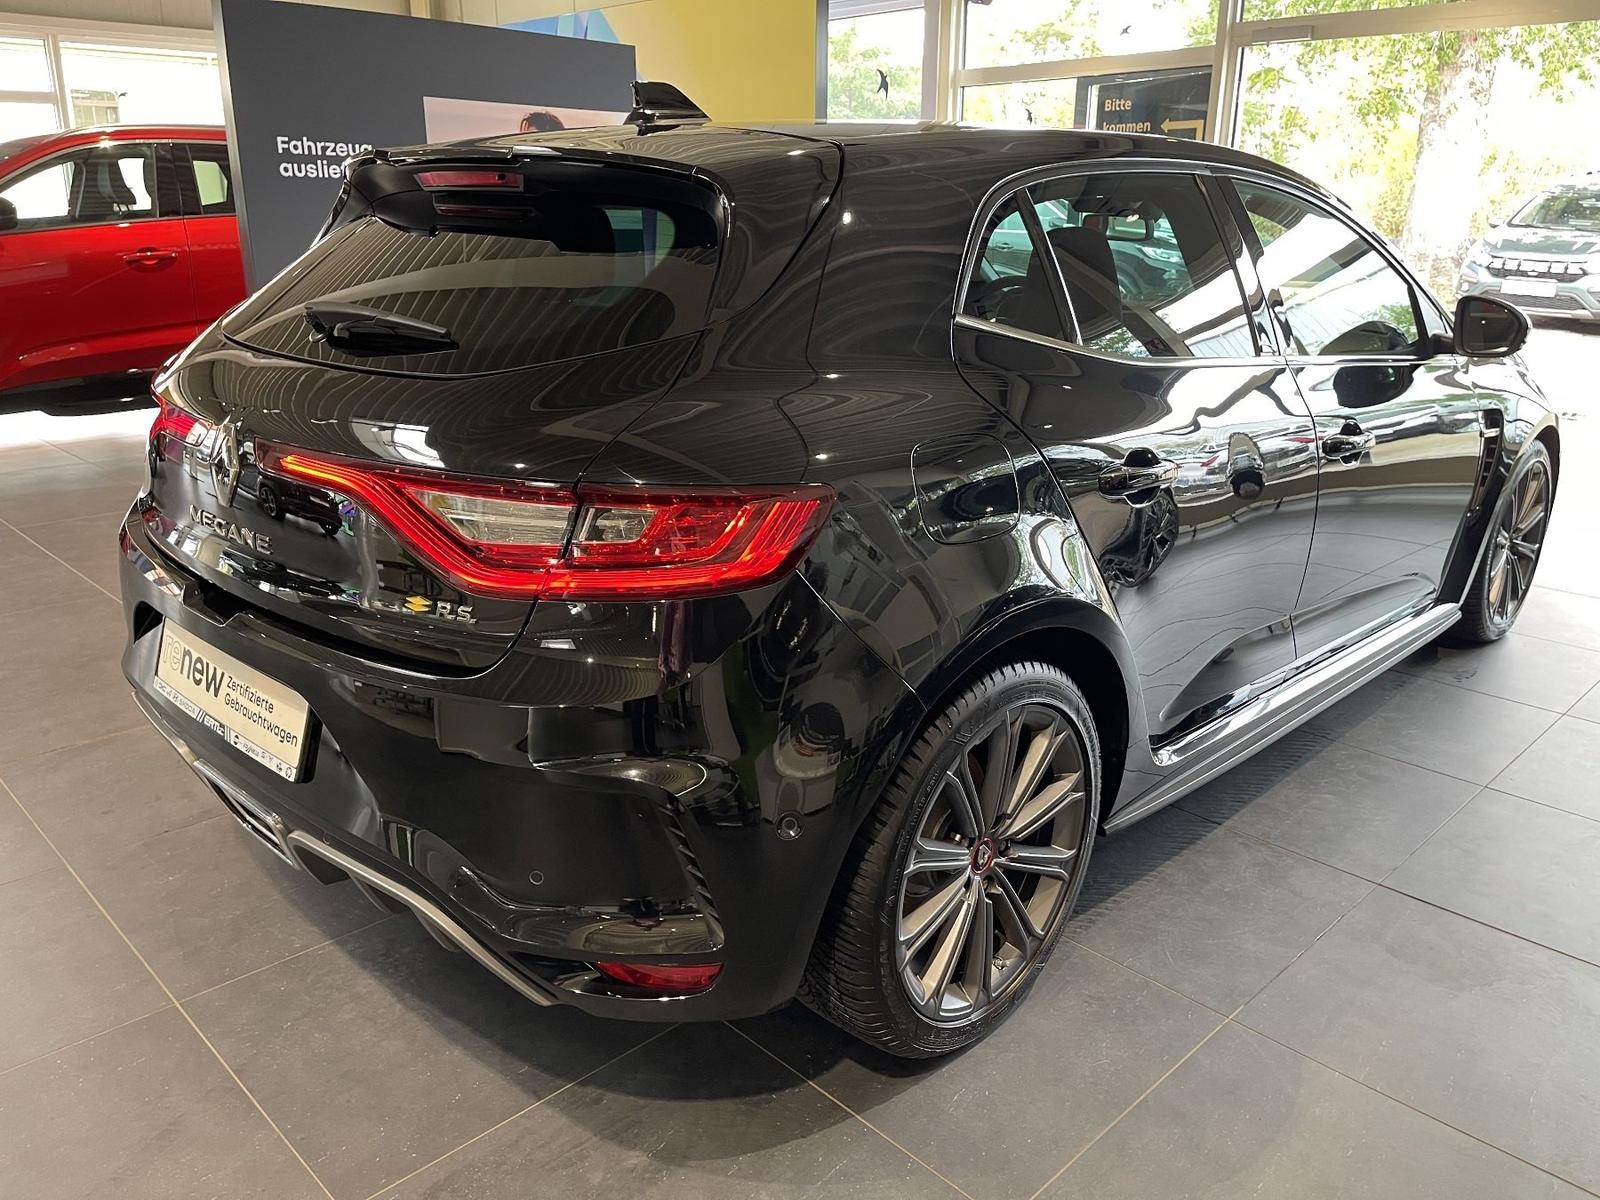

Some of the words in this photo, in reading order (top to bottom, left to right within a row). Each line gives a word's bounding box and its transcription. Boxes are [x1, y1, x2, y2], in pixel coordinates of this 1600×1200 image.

[1103, 121, 1151, 132] kommen
[1104, 98, 1132, 111] Bitte
[189, 504, 273, 555] MEGANE
[163, 634, 225, 698] renew
[226, 675, 274, 714] Zertifizierte
[224, 693, 298, 747] Gebrauchtwagen
